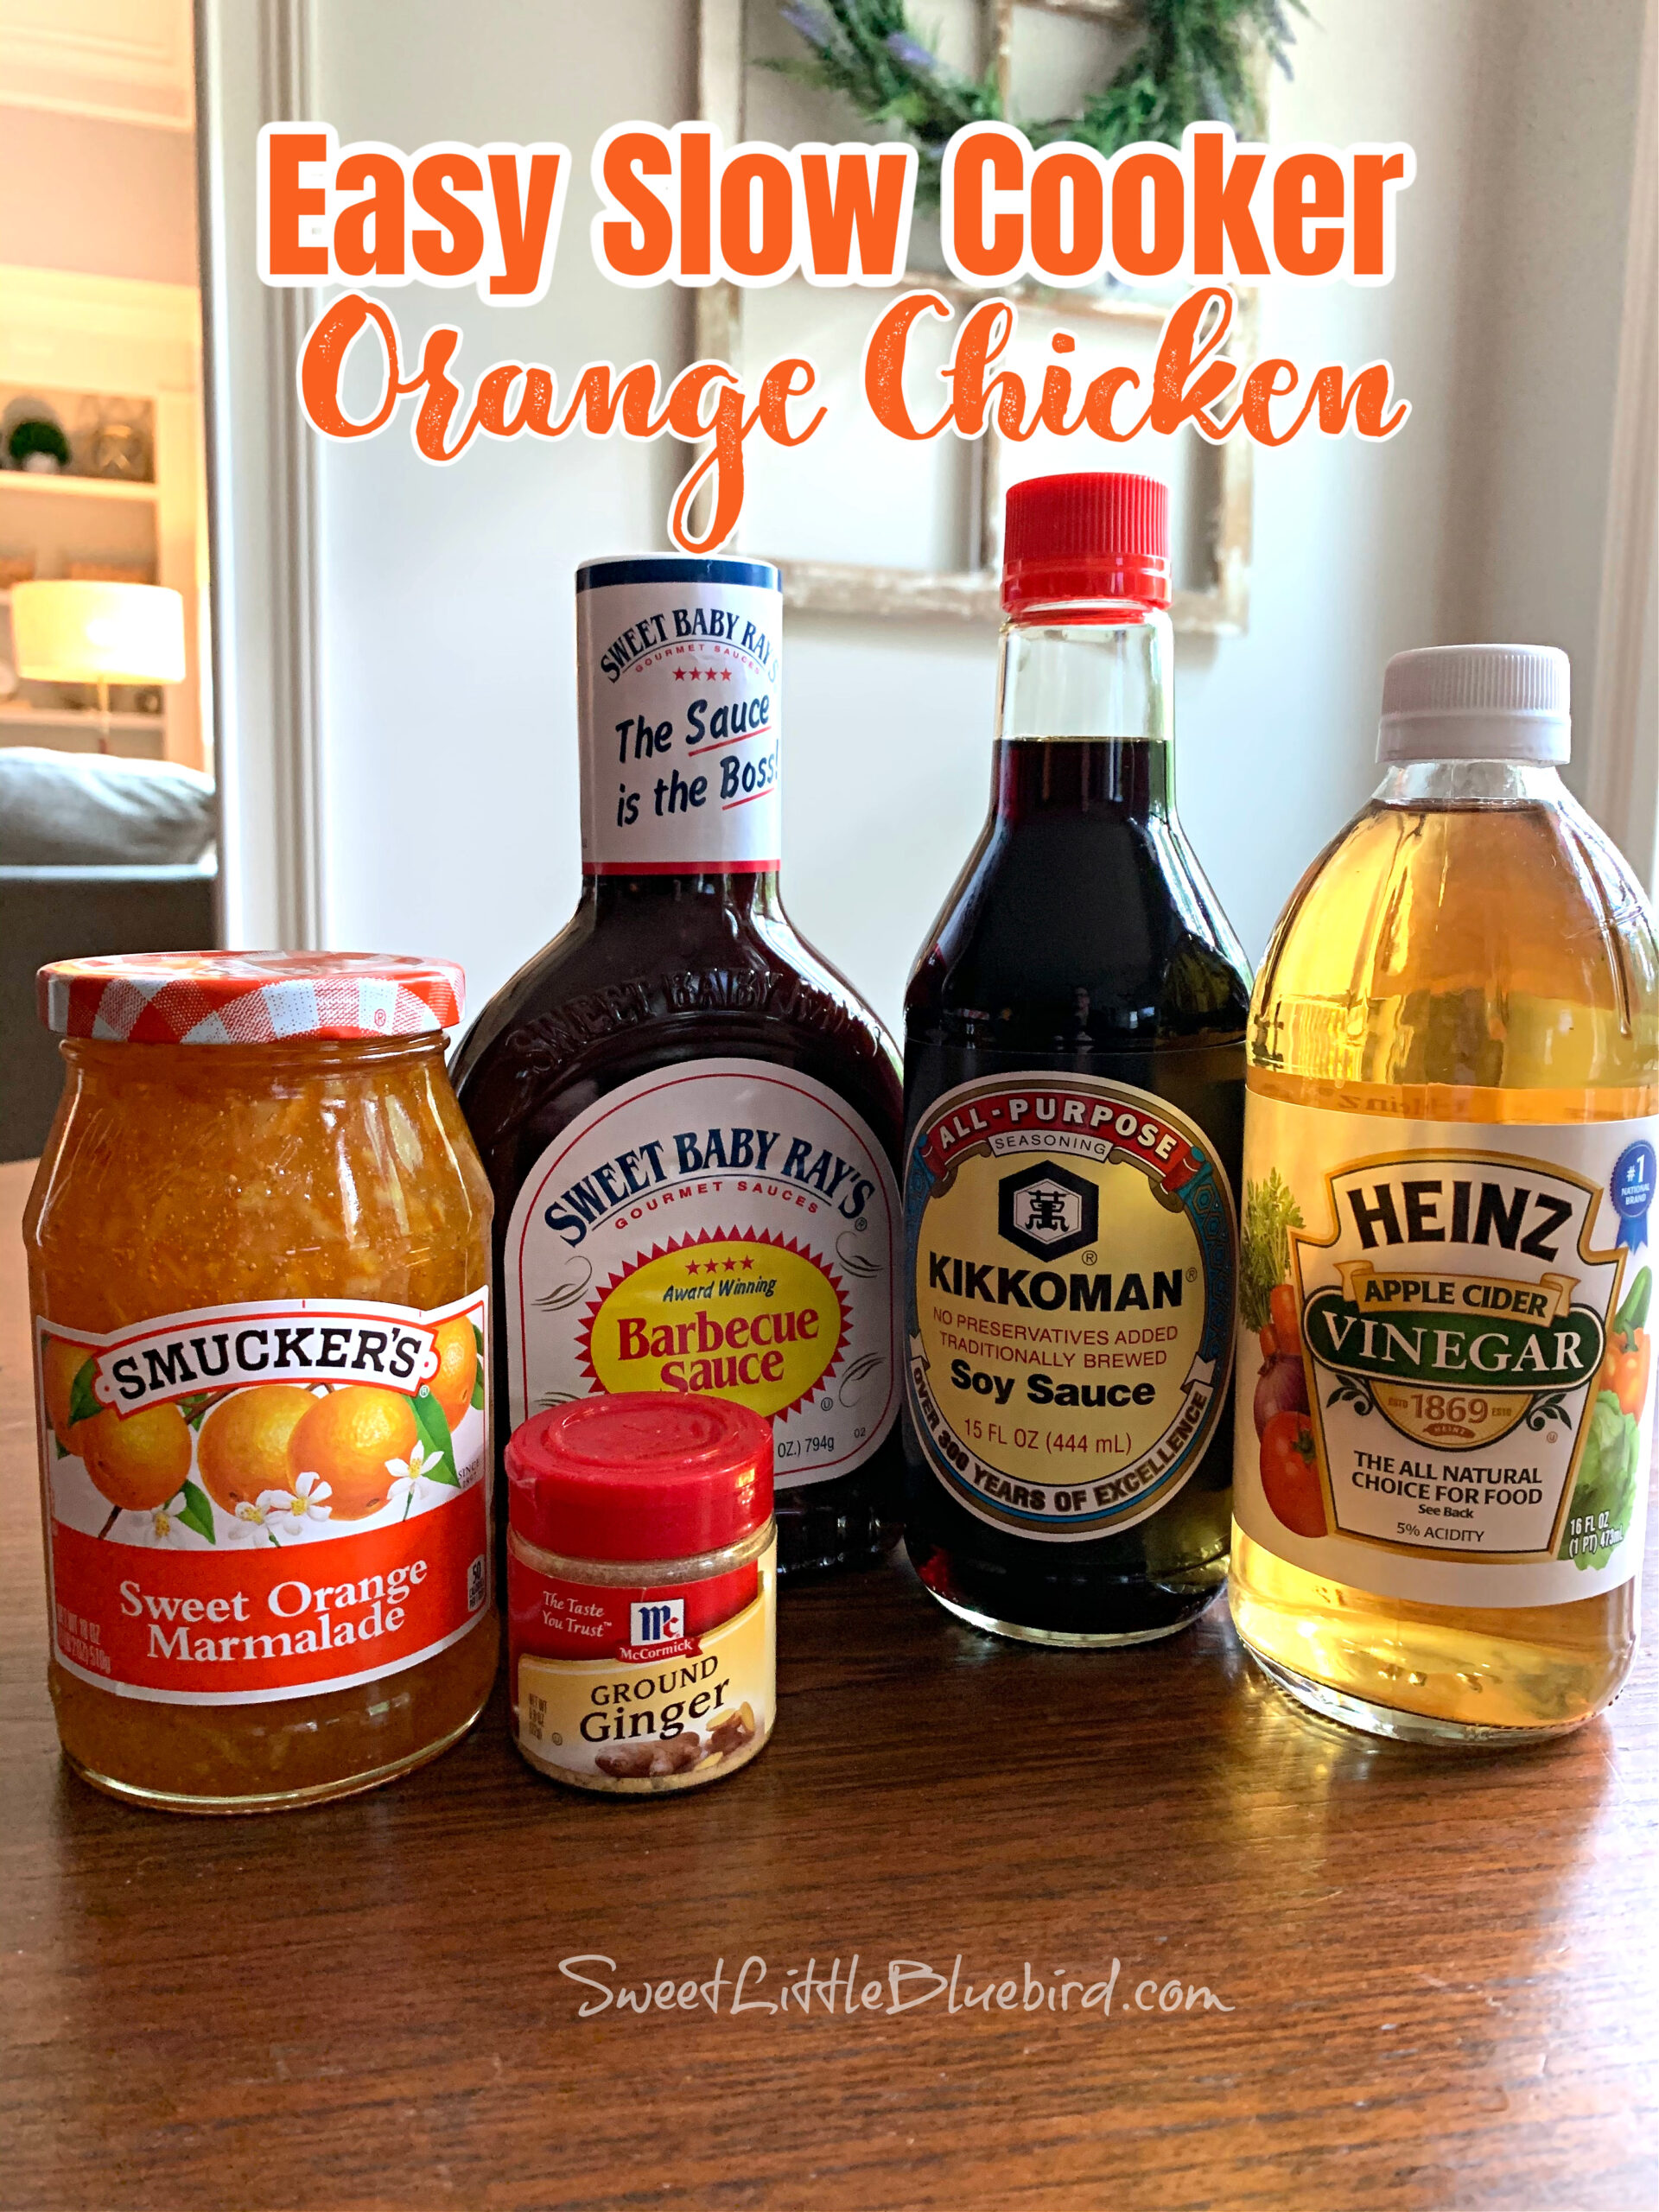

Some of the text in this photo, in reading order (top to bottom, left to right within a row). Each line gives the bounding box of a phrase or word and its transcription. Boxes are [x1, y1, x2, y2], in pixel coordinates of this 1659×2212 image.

[601, 613, 668, 683] SWEET
[672, 608, 740, 639] BABY
[635, 644, 760, 675] GOURMET SAUCES
[615, 694, 770, 764] The Sauce
[617, 739, 779, 828] is the Boss!
[663, 969, 784, 1014] BABY
[939, 1097, 1179, 1160] ALL-PURPOSE
[995, 1135, 1106, 1156] SEASONING
[544, 1128, 876, 1248] SWEET BABY RAY'S
[1626, 1154, 1645, 1183] #1
[614, 1181, 818, 1230] GOURMET SAUCES
[1621, 1182, 1650, 1197] NATIONAL
[1625, 1193, 1647, 1205] BRAND
[1347, 1180, 1573, 1262] HEINZ
[663, 1275, 777, 1303] Award Winning
[930, 1250, 1182, 1312] KIKKOMAN
[1364, 1279, 1548, 1319] APPLE CIDER
[617, 1307, 819, 1361] Barbecue
[933, 1306, 1178, 1346] NO PRESERVATIVES ADDED
[1321, 1310, 1585, 1373] VINEGAR
[111, 1326, 423, 1400] SMUCKER'S
[940, 1331, 1167, 1369] TRADITIONALLY BREWED
[660, 1350, 785, 1392] Sauce
[950, 1359, 1155, 1408] Soy Sauce
[1411, 1394, 1488, 1424] 1869
[778, 1435, 835, 1459] OZ.) 794g
[912, 1366, 1208, 1513] OVER 300 YEARS OF EXCELLENCE
[963, 1418, 1132, 1455] 15 FL OZ (444 mL)
[1433, 1426, 1466, 1435] HEINZ
[1353, 1450, 1542, 1485] THE ALL NATURAL
[1351, 1471, 1542, 1505] CHOICE FOR FOOD
[1418, 1503, 1474, 1520] See Back
[1570, 1510, 1610, 1536] 16 FL OZ
[1396, 1522, 1484, 1542] 5% ACIDITY
[1569, 1537, 1579, 1559] (1
[1582, 1534, 1598, 1554] PT)
[119, 1580, 250, 1623] Sweet
[268, 1560, 428, 1618] Orange
[543, 1591, 605, 1618] The Taste
[147, 1600, 404, 1661] Marmalade
[542, 1610, 563, 1630] You
[620, 1638, 694, 1661] McCormick
[591, 1656, 718, 1707] GROUND
[579, 1678, 729, 1742] Ginger
